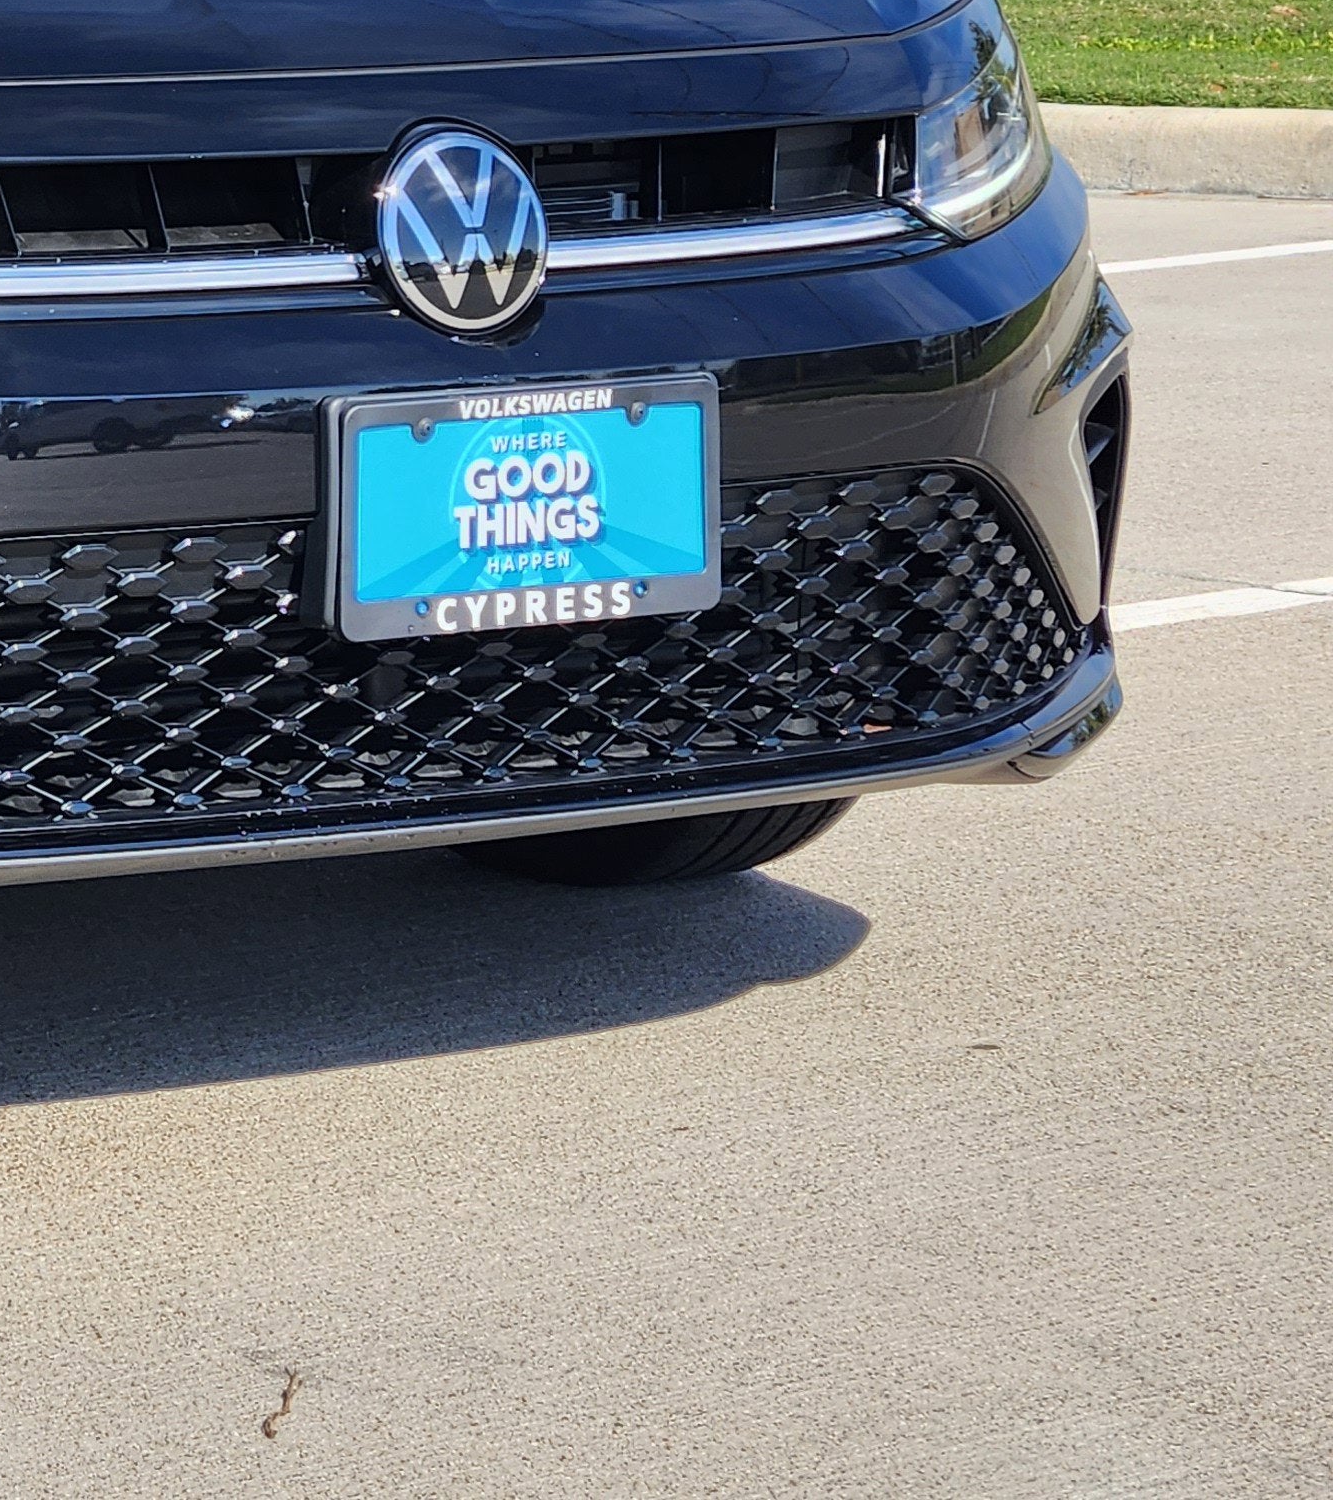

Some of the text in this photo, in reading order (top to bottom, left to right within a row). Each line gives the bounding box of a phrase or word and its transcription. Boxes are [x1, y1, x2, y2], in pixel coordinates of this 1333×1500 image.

[459, 388, 613, 420] VOLKSWAGEN
[491, 430, 567, 453] WHERE
[464, 451, 592, 502] GOOD
[453, 494, 602, 550] THINGS
[487, 550, 572, 575] HAPPEN
[436, 581, 632, 633] CYPRESS
